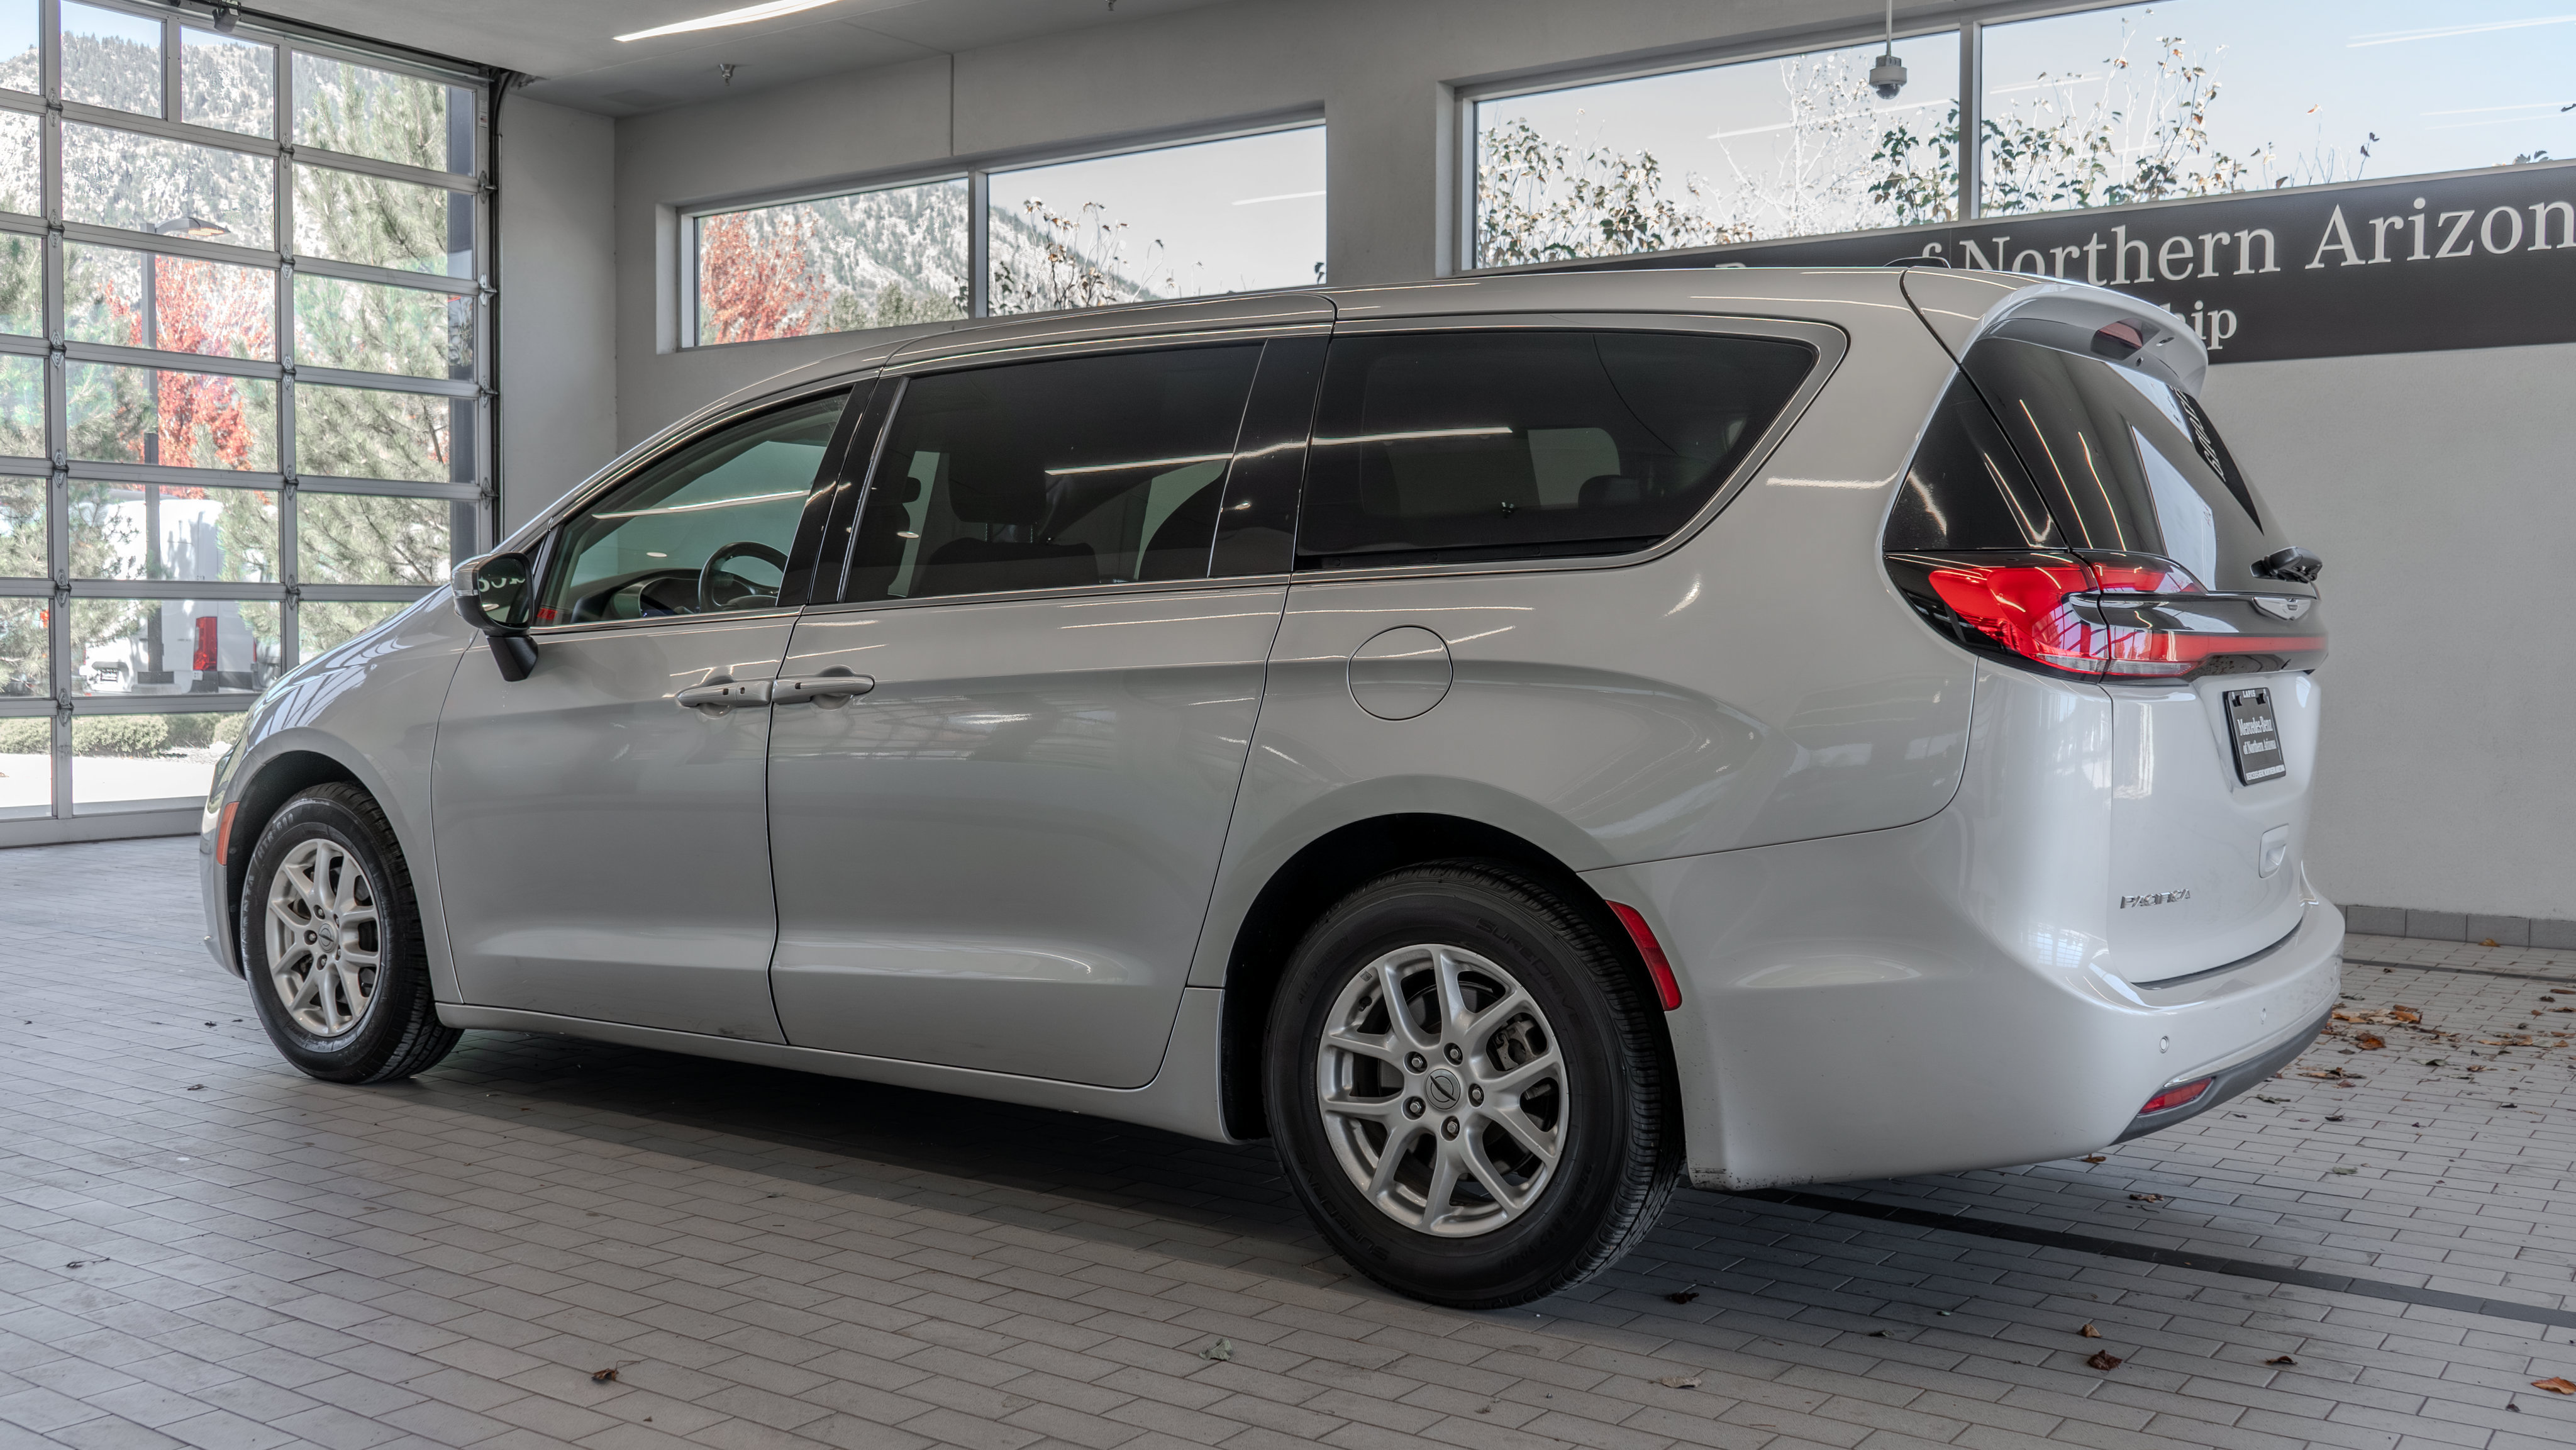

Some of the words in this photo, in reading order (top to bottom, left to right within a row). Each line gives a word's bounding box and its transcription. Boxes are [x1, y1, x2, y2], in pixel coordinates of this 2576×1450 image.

[1959, 224, 2281, 286] Northern
[2304, 197, 2576, 269] Arizon
[2237, 716, 2273, 736] Mercedes-Benz
[2119, 888, 2191, 909] PACIFICA
